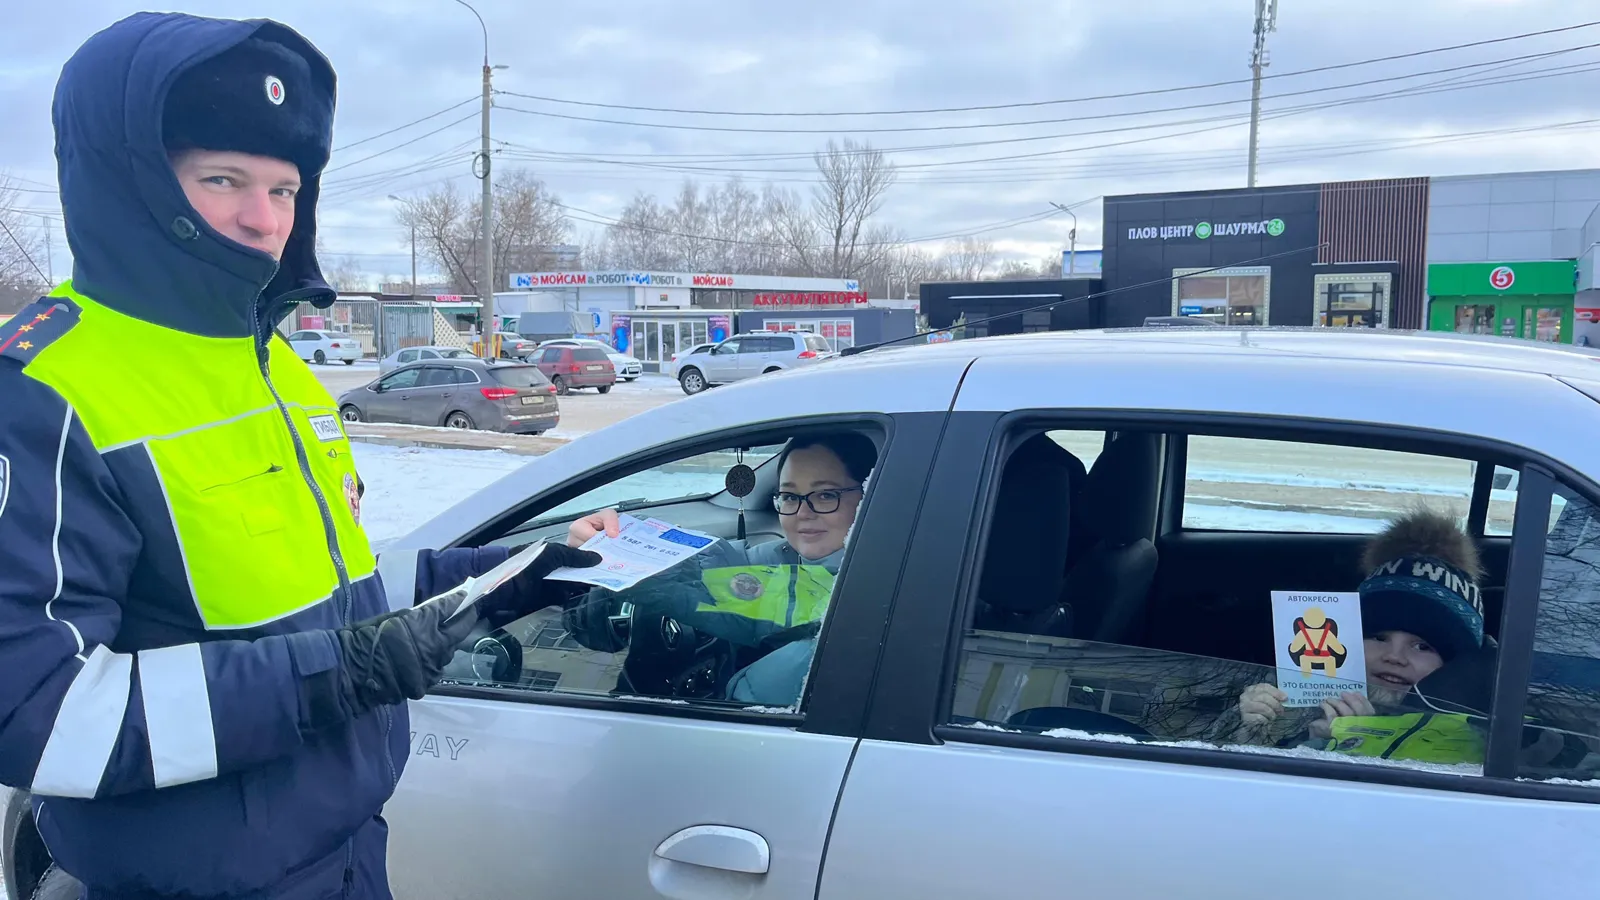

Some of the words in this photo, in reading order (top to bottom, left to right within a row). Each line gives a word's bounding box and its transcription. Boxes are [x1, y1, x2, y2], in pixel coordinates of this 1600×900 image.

[1128, 228, 1157, 239] ПЛОВ
[1160, 225, 1194, 241] ЦЕНТР
[1214, 221, 1266, 235] ШАУРМА
[540, 273, 586, 285] МОЙСАМ
[596, 274, 626, 284] РОБОТ
[651, 275, 675, 285] РОБОТ
[693, 274, 727, 286] МОЙСАМ
[1495, 268, 1509, 286] 5
[753, 291, 868, 306] АККУМУЛЯТОРЫ
[313, 420, 339, 434] ГИБДД
[1287, 595, 1339, 603] АВТОКРЕСЛО
[1299, 682, 1363, 690] БЕЗОПАСНОСТЬ
